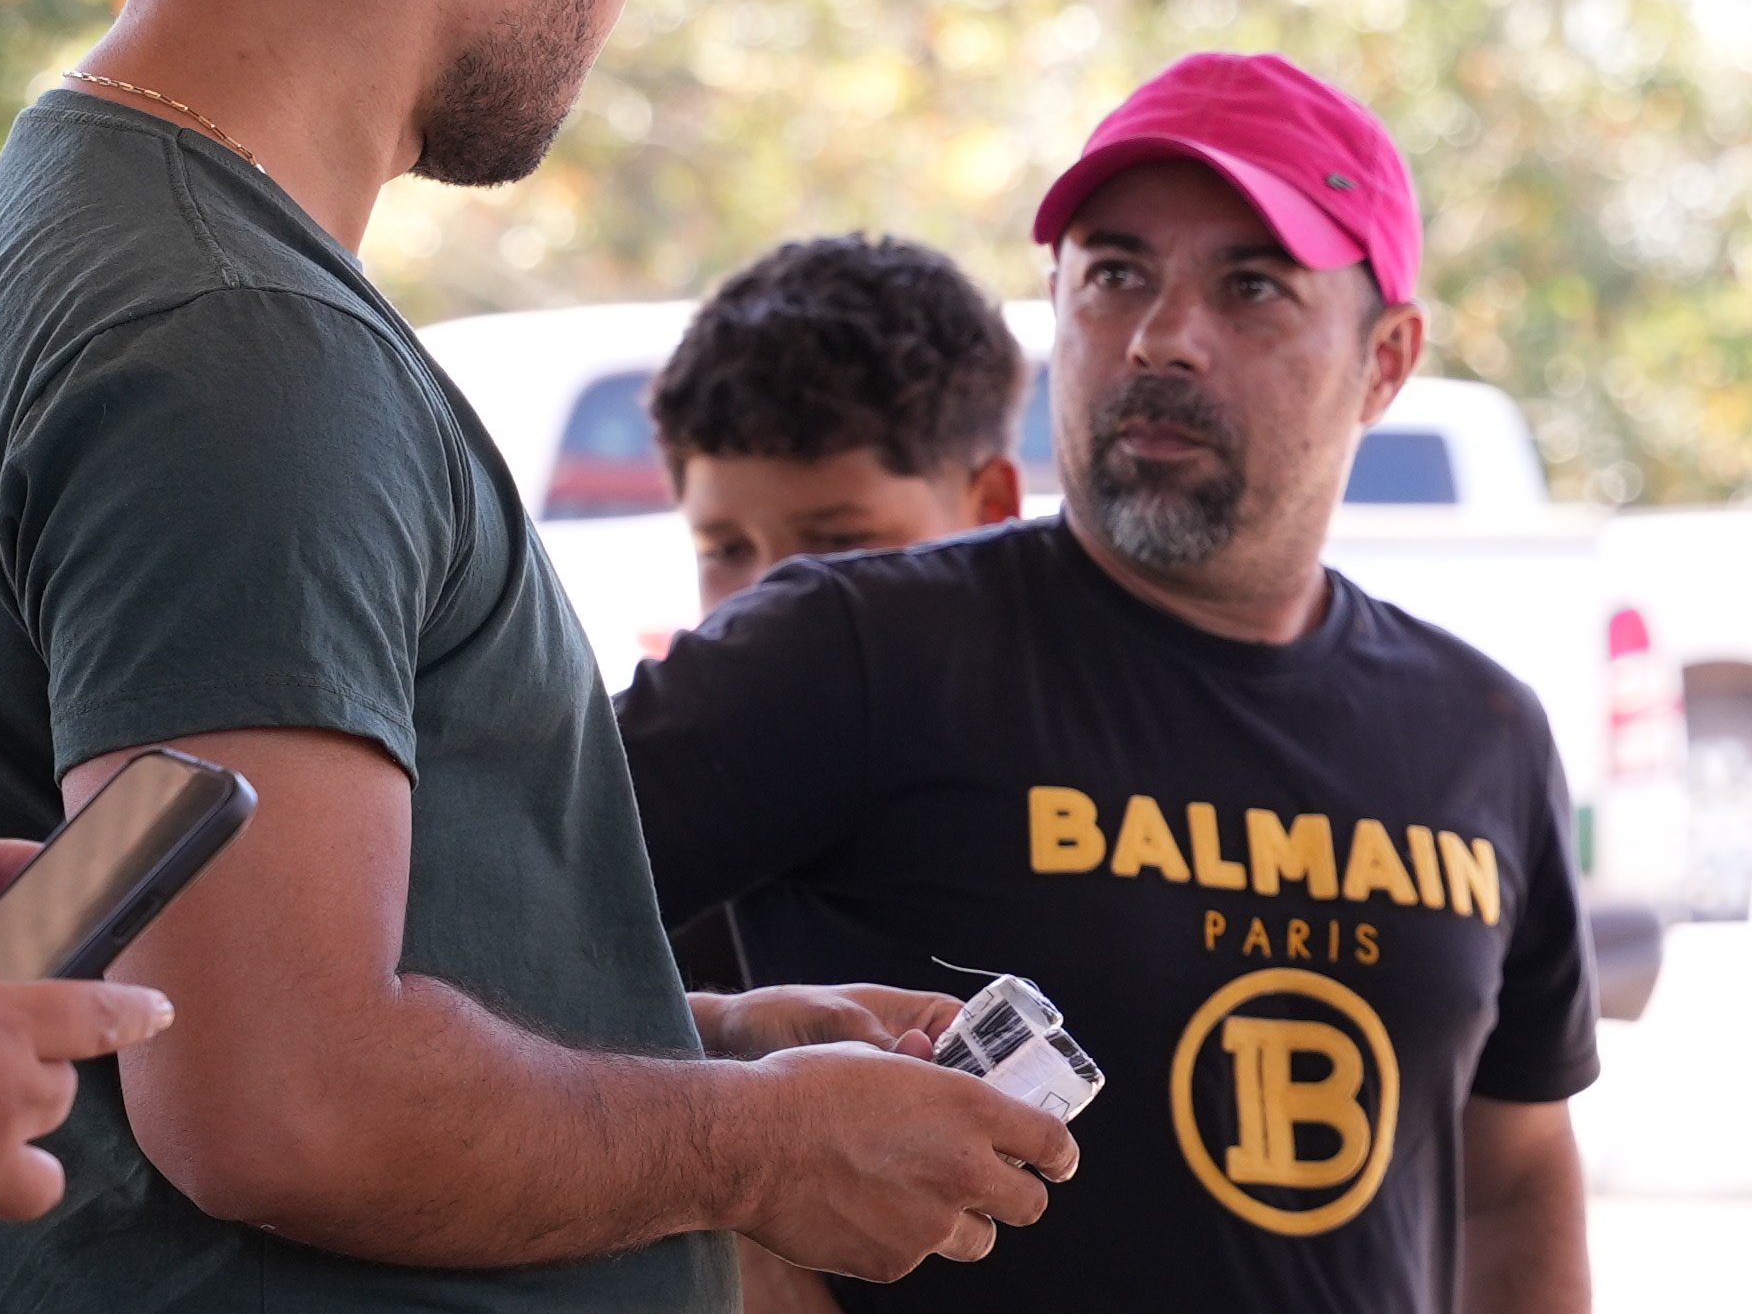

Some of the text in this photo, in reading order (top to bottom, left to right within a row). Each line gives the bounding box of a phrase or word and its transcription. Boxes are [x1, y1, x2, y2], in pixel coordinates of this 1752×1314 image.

[1028, 785, 1501, 926] BALMAIN
[1203, 909, 1381, 965] PARIS
[1222, 1015, 1372, 1187] B
